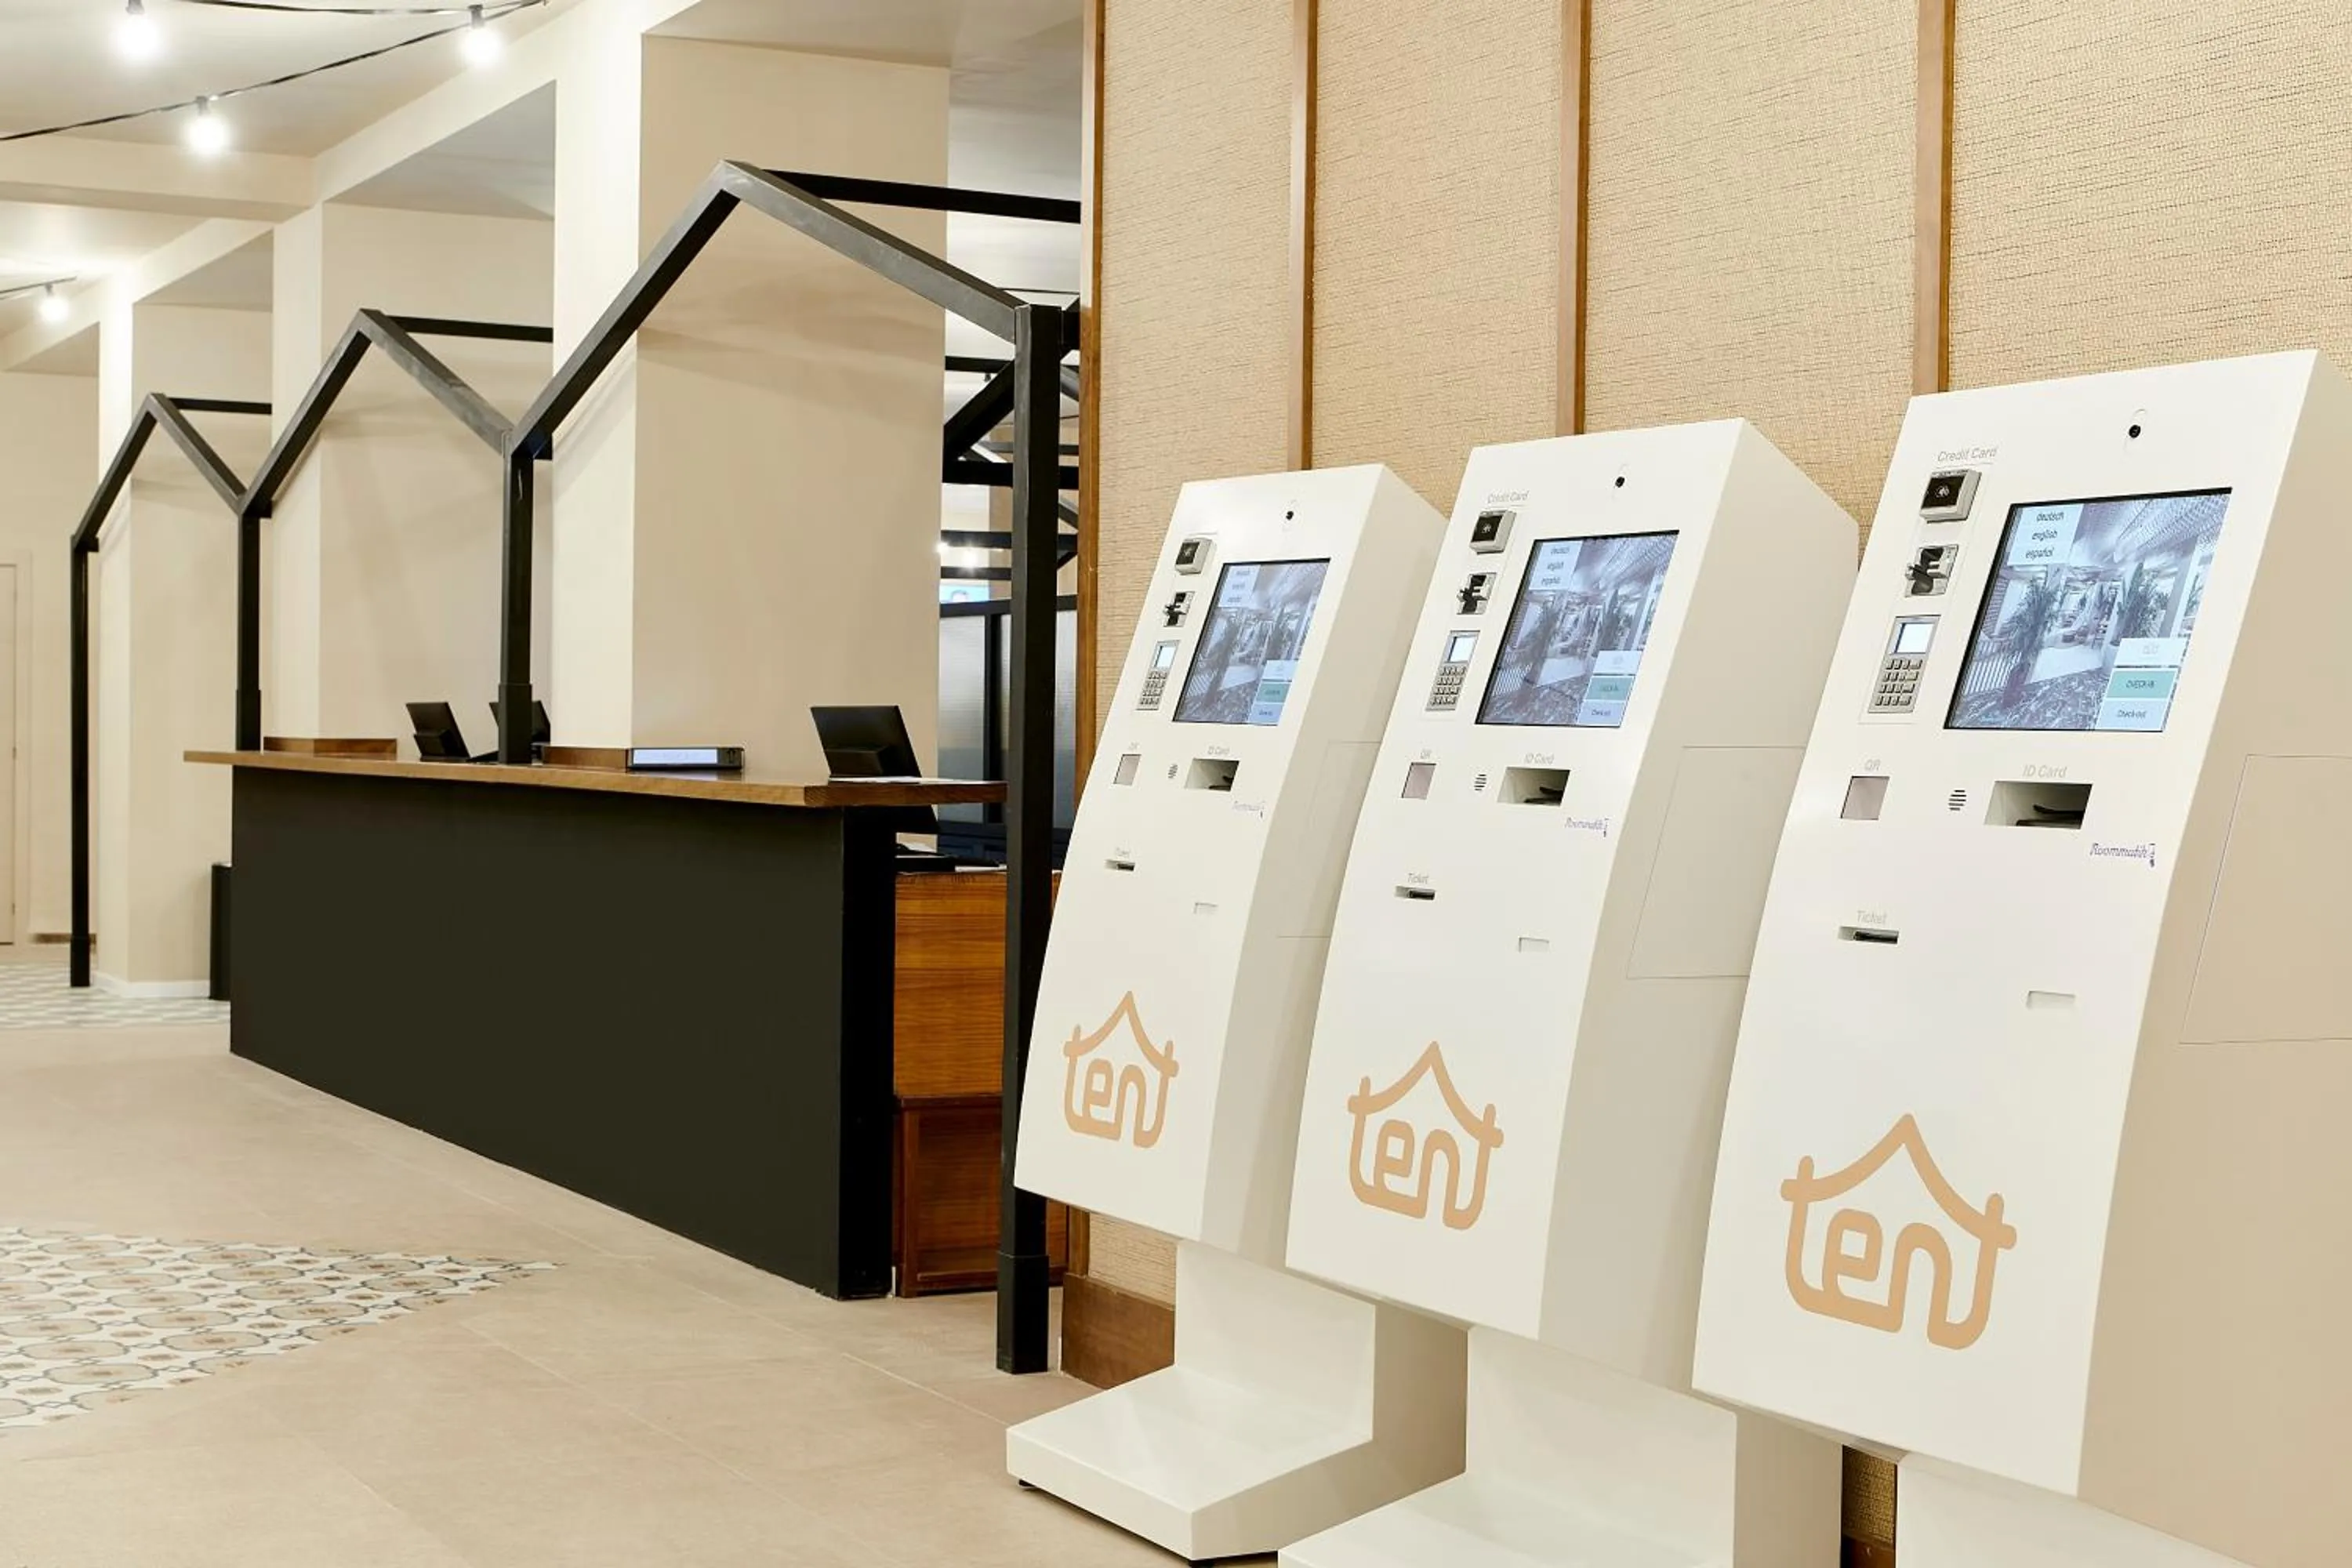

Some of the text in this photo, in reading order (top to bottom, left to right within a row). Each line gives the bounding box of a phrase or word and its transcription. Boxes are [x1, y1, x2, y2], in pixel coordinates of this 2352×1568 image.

[1936, 445, 1998, 463] Credit Card
[1864, 758, 1882, 773] QR
[2021, 764, 2068, 779] ID Card
